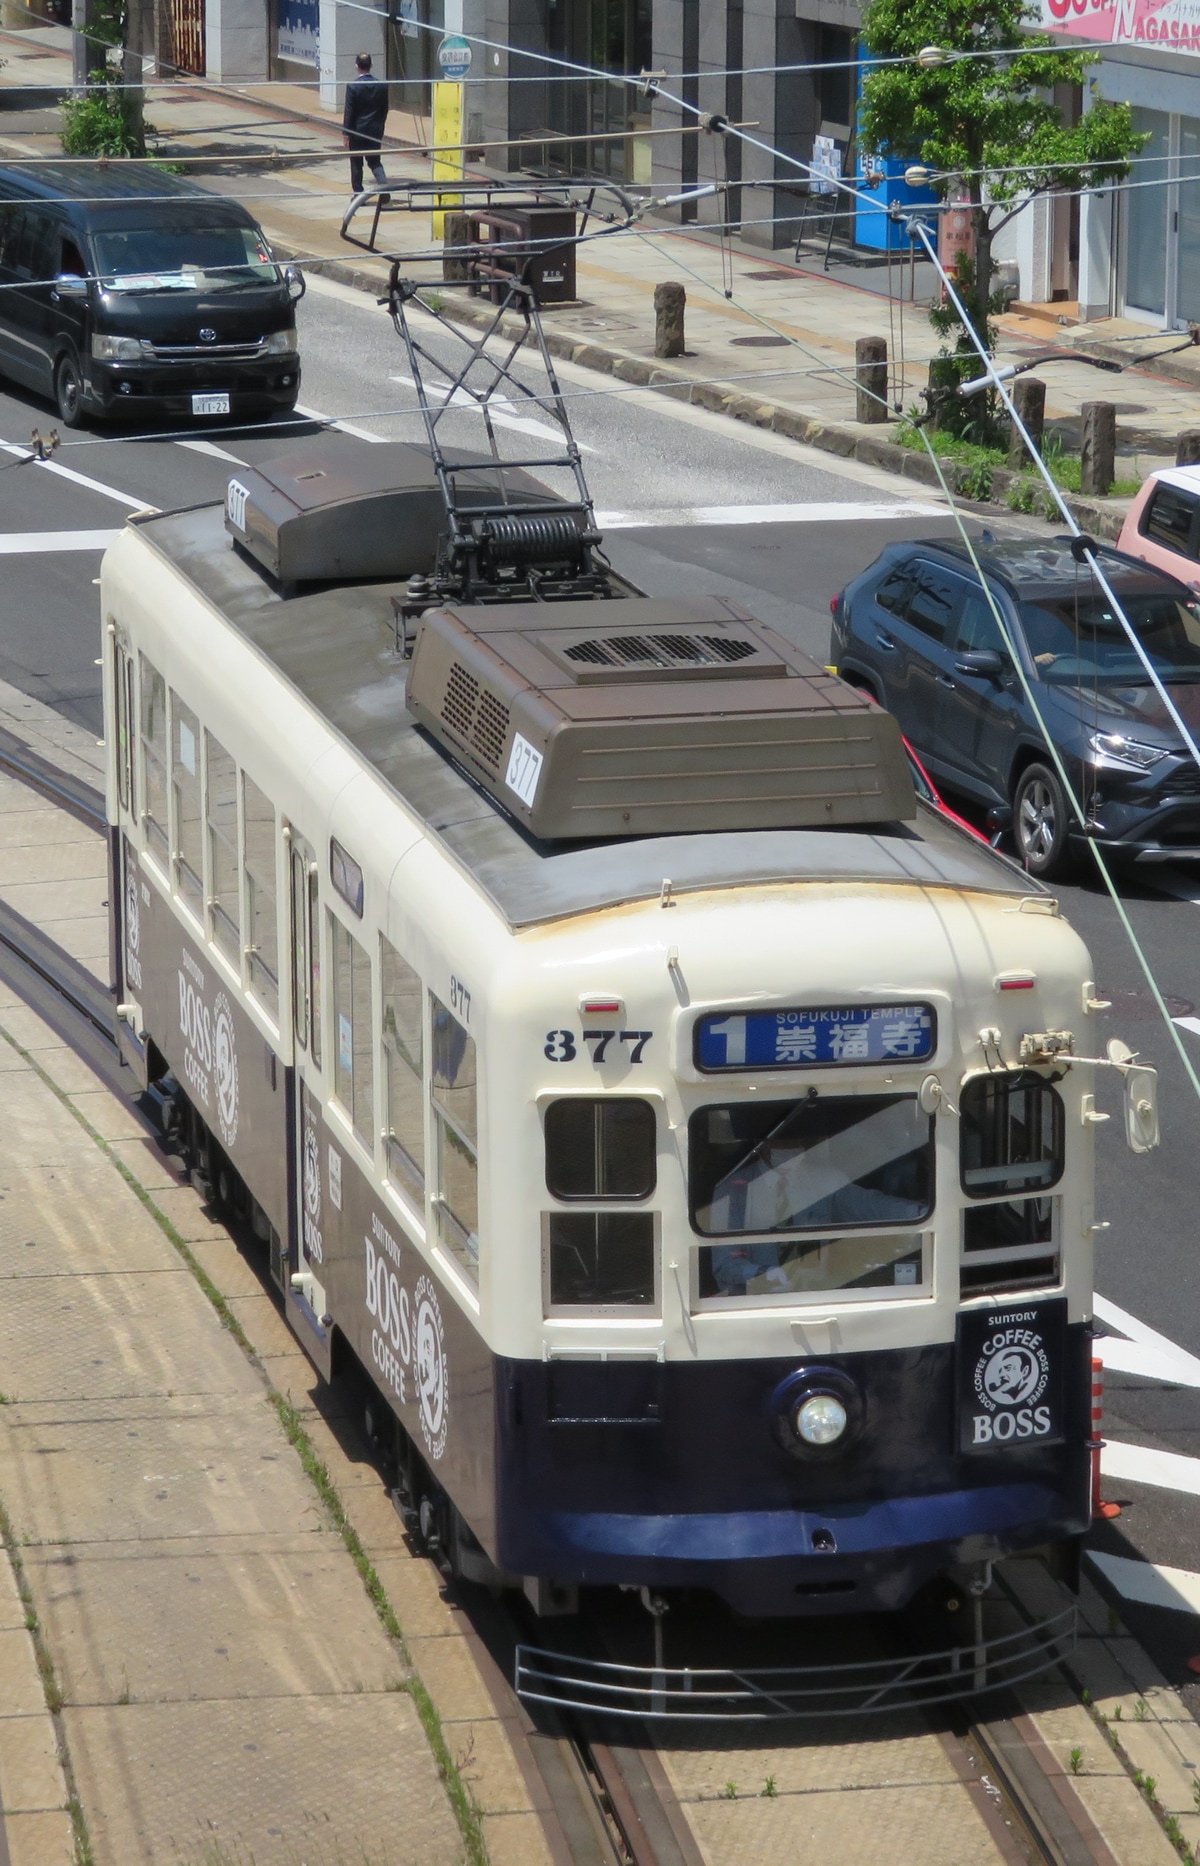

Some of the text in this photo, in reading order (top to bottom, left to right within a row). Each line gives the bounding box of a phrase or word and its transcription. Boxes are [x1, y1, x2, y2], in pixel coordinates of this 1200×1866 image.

[202, 402, 228, 413] 11-22
[510, 741, 539, 797] 377
[178, 969, 212, 1073] BOSS
[450, 975, 471, 1024] 377
[776, 1007, 923, 1024] SOFUKUJI TEMPLE
[544, 1030, 653, 1064] 377
[710, 1016, 747, 1064] 1
[775, 1021, 922, 1062] 崇福寺
[184, 1047, 209, 1106] COFFEE
[365, 1235, 410, 1365] BOSS
[988, 1311, 1038, 1326] SUNTORY
[982, 1329, 1042, 1355] COFFEE
[372, 1329, 406, 1405] COFFEE
[974, 1357, 996, 1412] BOSS COFFEE
[1026, 1349, 1049, 1406] BOSS COFFEE
[972, 1406, 1051, 1444] BOSS
